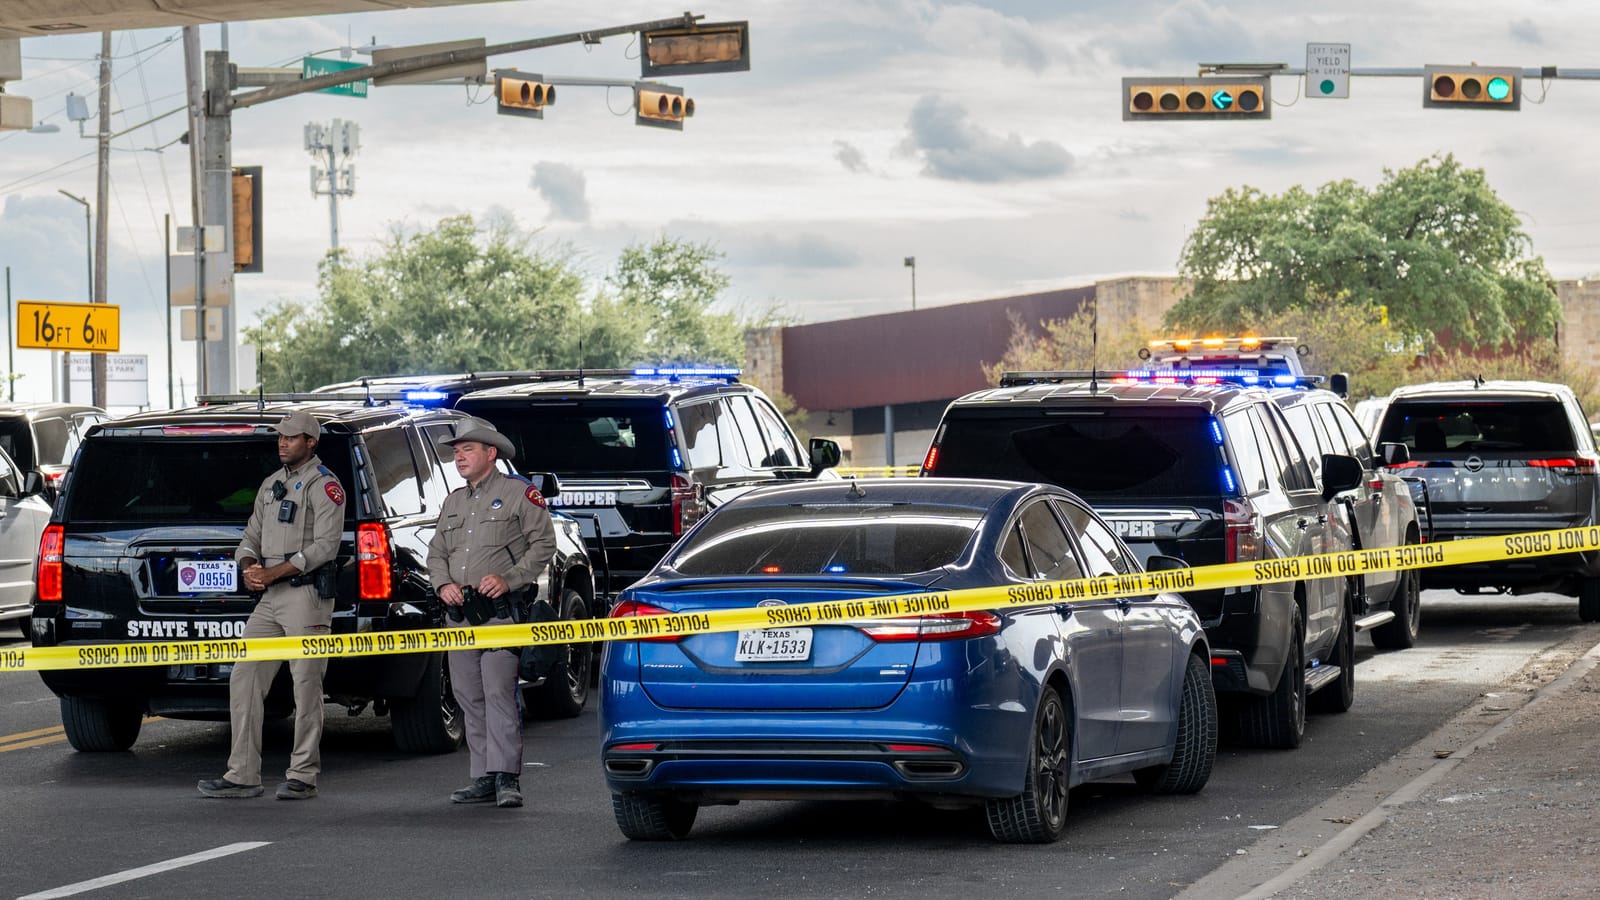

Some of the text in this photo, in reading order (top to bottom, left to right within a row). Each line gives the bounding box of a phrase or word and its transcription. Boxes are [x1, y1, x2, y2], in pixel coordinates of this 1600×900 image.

[1317, 56, 1340, 65] YIELD
[552, 491, 617, 506] ROOPER
[1505, 533, 1552, 555] CROSS
[1557, 530, 1584, 550] NOT
[1254, 544, 1444, 581] POLICE LINE DO NOT CROSS
[199, 572, 232, 586] 09550
[1007, 570, 1194, 604] POLICE LINE DO NOT CROSS
[766, 594, 950, 625] POLICE LINE DO NOT CROSS
[127, 620, 188, 637] STATE
[531, 614, 710, 642] POLICE LINE DO NOT CROSS
[79, 641, 247, 666] POLICE LINE DO NOT CROSS
[302, 629, 475, 656] POLICE LINE DO NOT CROSS
